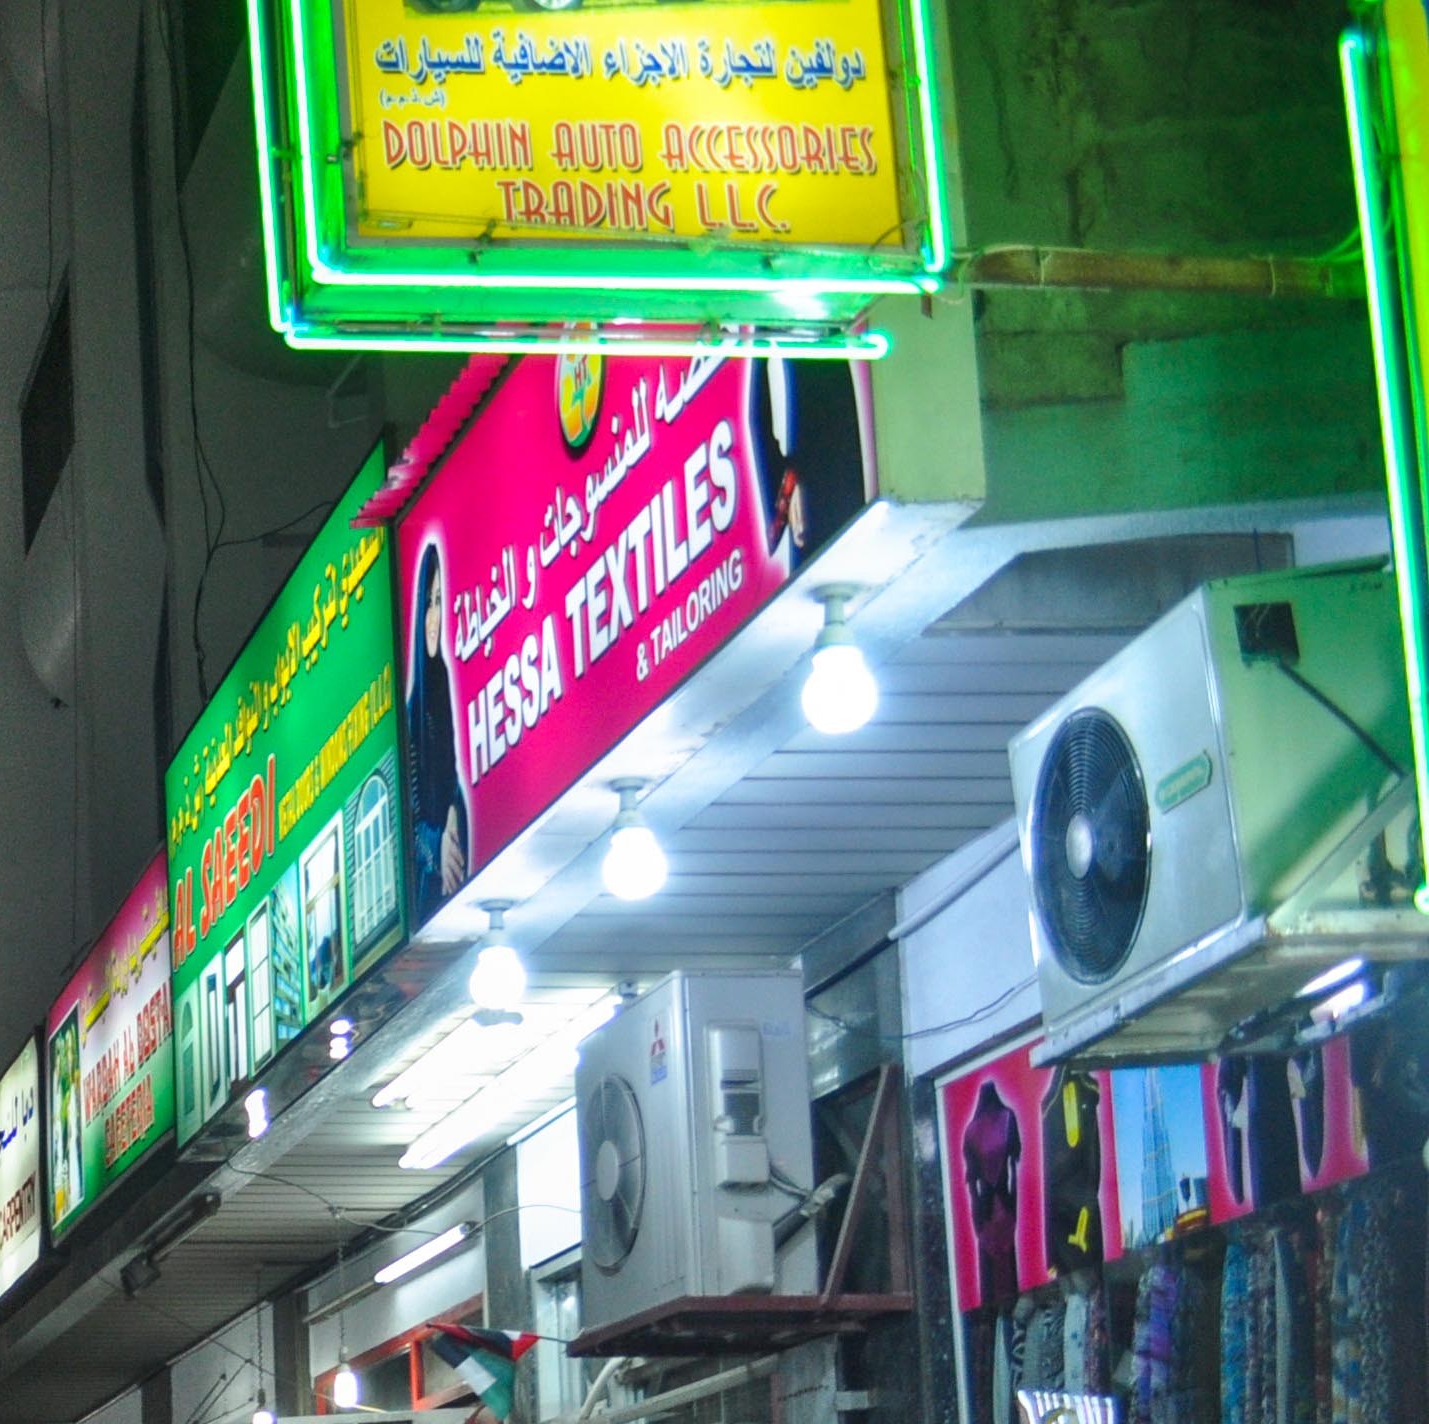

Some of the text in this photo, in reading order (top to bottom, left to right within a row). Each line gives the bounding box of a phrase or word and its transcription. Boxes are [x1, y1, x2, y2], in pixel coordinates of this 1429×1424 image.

[375, 29, 866, 91] دولفين لتجارة الاجزاء الاضافية للسيارات
[382, 119, 878, 174] DOLPHIN AUTO ACCESSORIES
[497, 179, 675, 233] TRADING
[539, 372, 653, 571] للمنسوجات
[452, 544, 517, 667] الخياطة
[466, 417, 739, 787] HESSA TEXTILES
[522, 544, 539, 610] و
[636, 546, 745, 683] & TAILORING
[172, 752, 277, 972] AL SAEEDI
